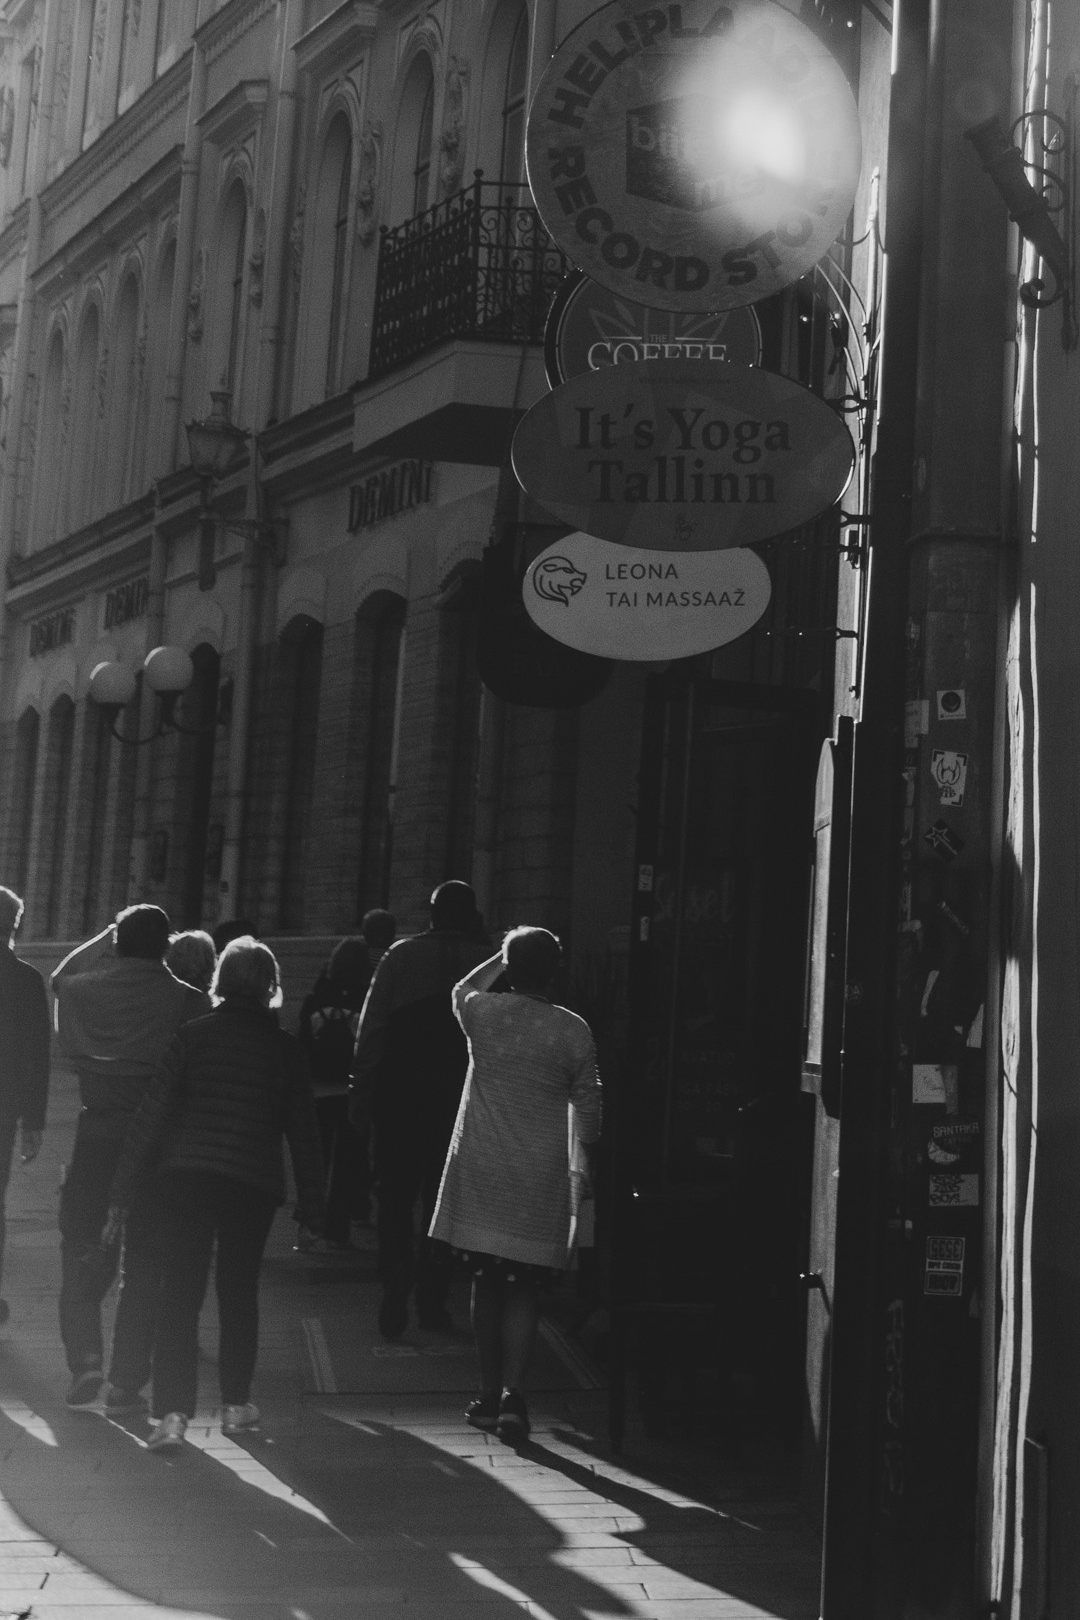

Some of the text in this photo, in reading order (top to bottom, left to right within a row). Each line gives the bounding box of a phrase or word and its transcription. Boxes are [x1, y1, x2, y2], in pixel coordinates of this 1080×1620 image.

[548, 146, 709, 291] RECORD
[649, 334, 668, 343] THE
[575, 402, 791, 464] It's Yoga
[588, 455, 778, 503] Tallinn
[605, 563, 679, 580] LEONA
[606, 588, 746, 608] TAI MASSAAŽ
